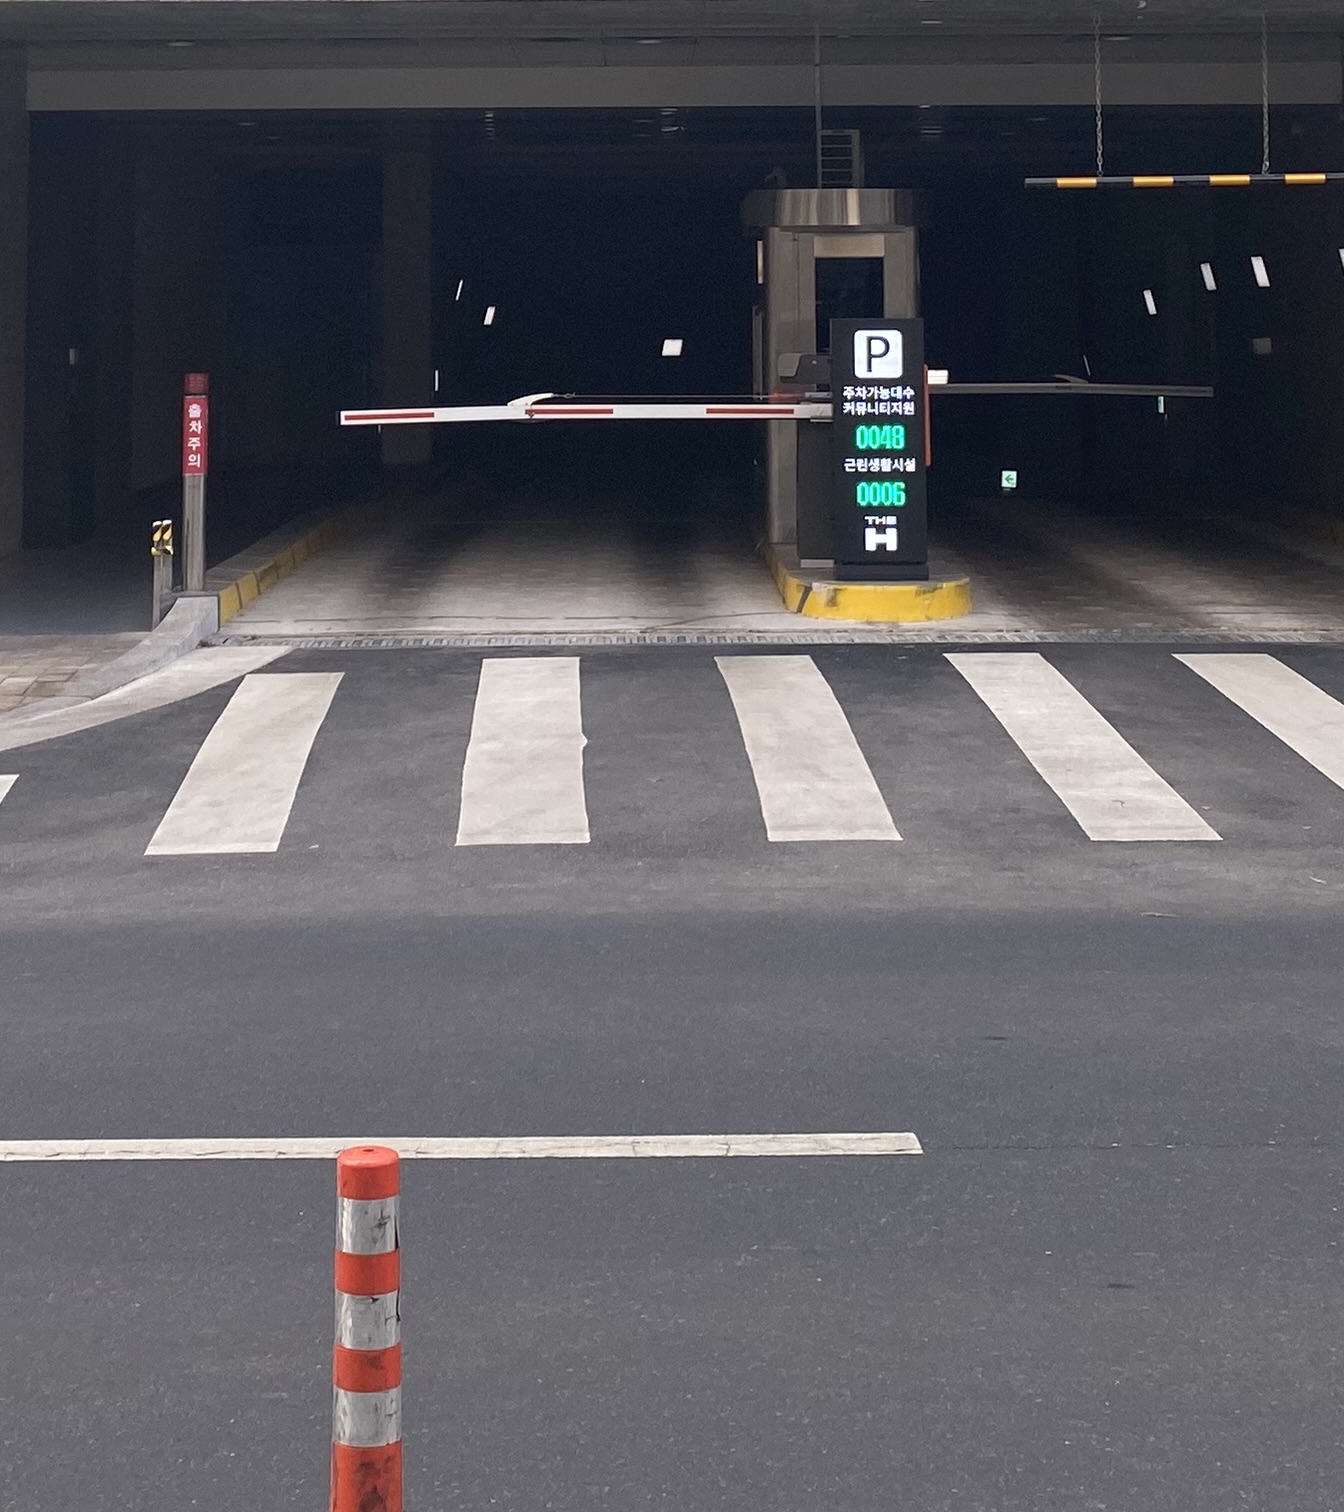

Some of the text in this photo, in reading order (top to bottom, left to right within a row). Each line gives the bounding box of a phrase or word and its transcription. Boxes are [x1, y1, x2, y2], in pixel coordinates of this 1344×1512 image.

[866, 335, 891, 373] P
[843, 385, 915, 400] 주차가능대수
[843, 401, 915, 416] 커뮤니티지원
[187, 403, 203, 468] 출차주의
[856, 424, 905, 450] 0048
[844, 457, 916, 472] 근린생활시설
[856, 481, 906, 506] 0006
[864, 516, 897, 525] THE
[864, 527, 898, 551] H
